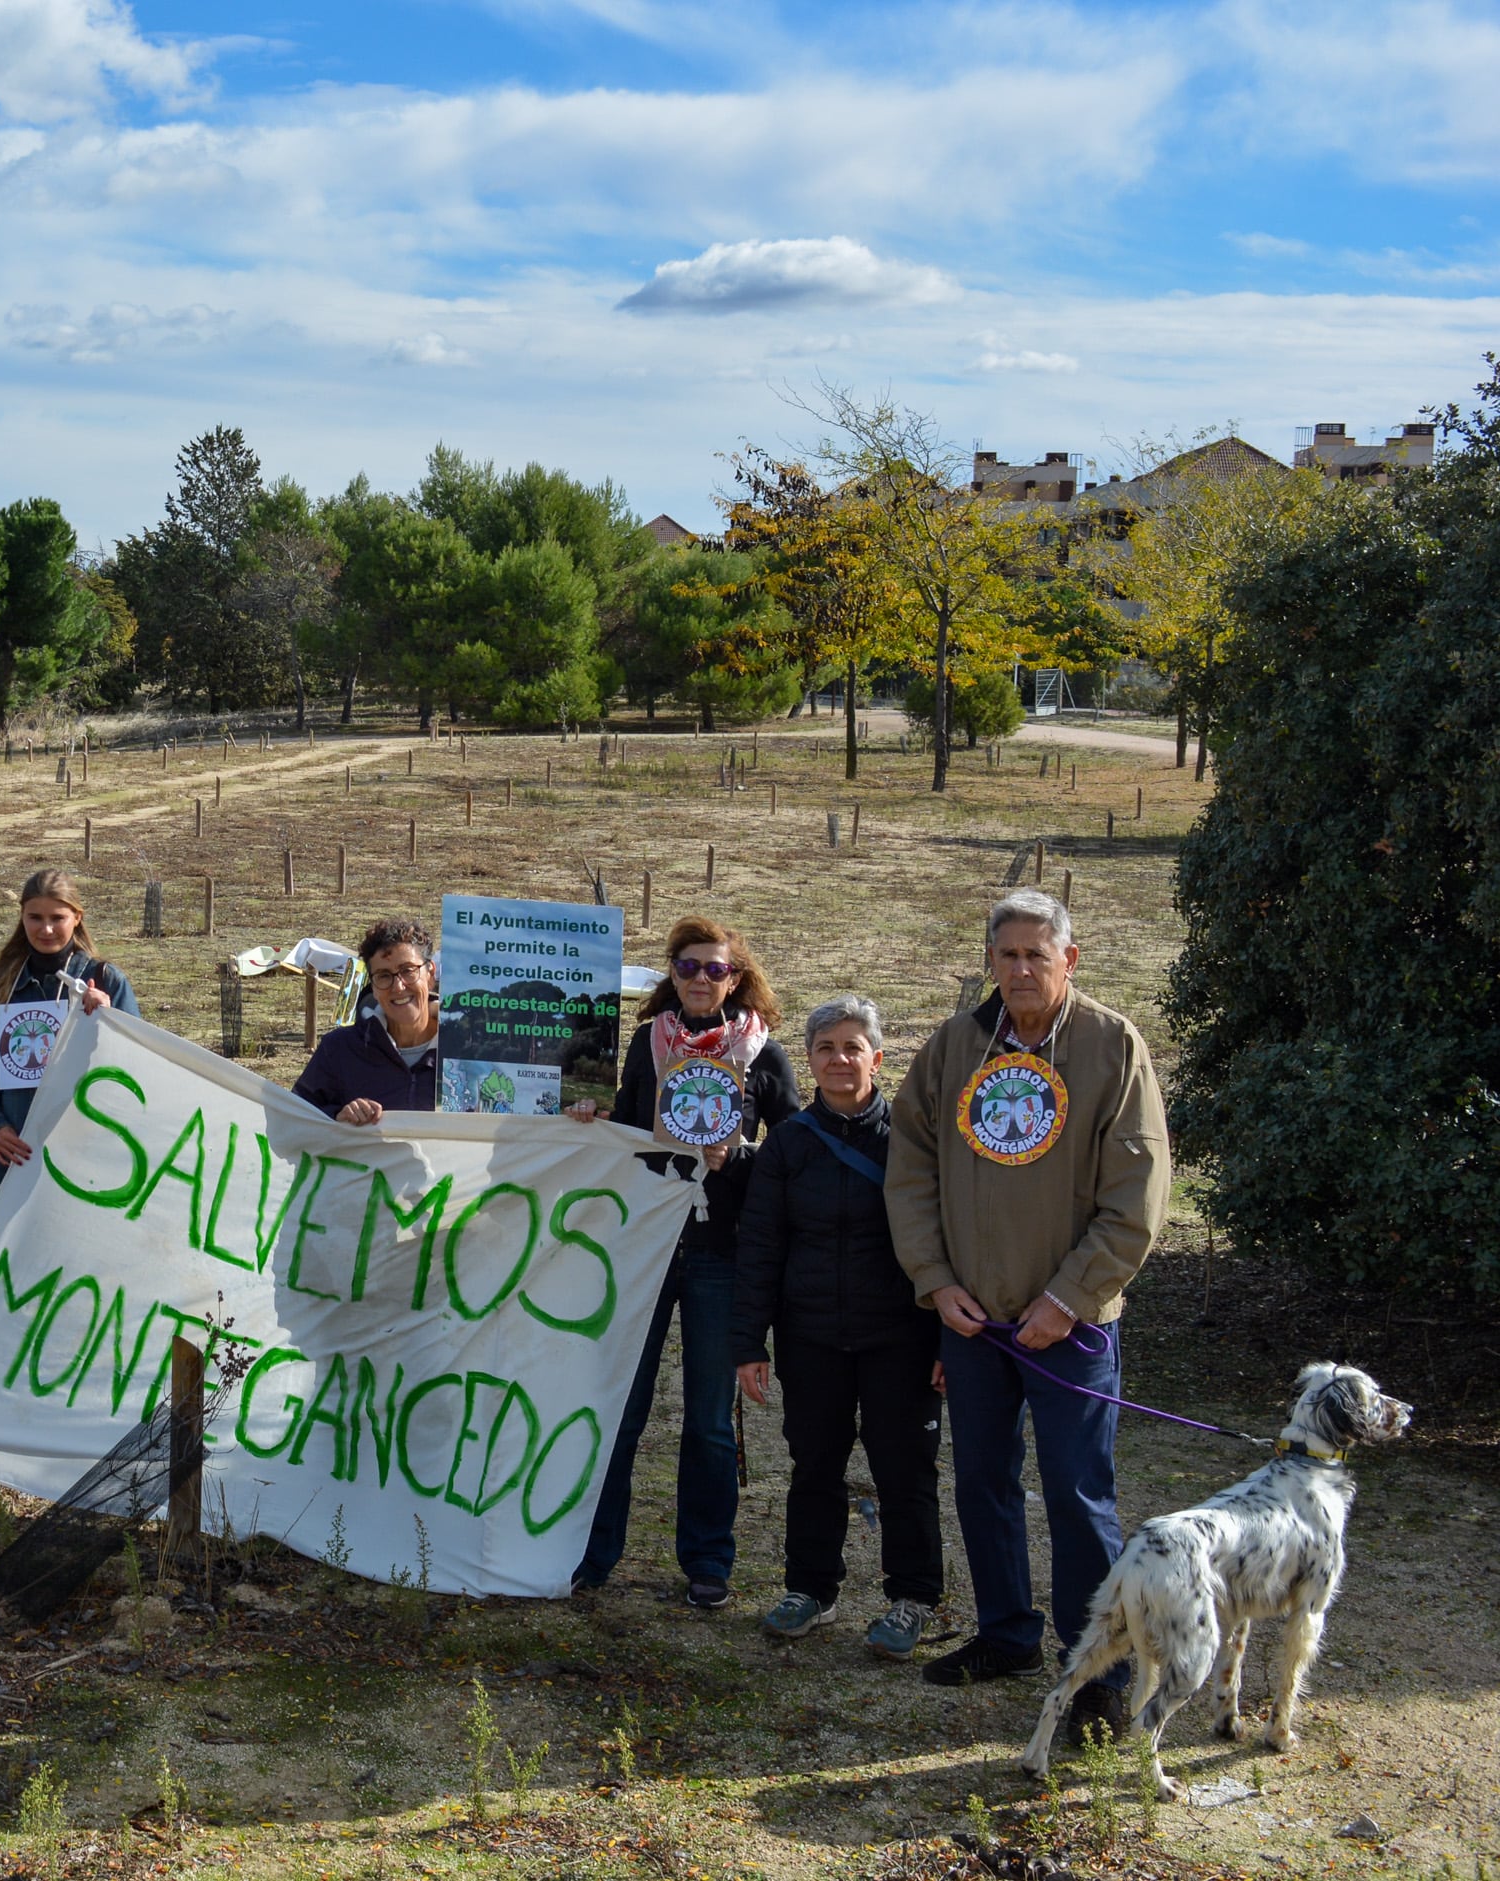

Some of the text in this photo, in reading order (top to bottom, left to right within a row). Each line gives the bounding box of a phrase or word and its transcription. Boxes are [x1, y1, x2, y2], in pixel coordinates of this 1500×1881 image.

[456, 911, 610, 935] El Ayuntamiento
[484, 940, 580, 957] permite la
[469, 963, 593, 983] especulación
[443, 992, 617, 1016] y deforestación de
[5, 1011, 61, 1034] SALVEMOS
[485, 1021, 573, 1038] un monte
[668, 1067, 739, 1095] SALVEMOS
[976, 1068, 1049, 1098] SALVEMOS
[660, 1110, 742, 1145] MONTEGANCEDO
[971, 1109, 1056, 1154] MONTEGANCEDO
[42, 1065, 629, 1341] SALVEMOS
